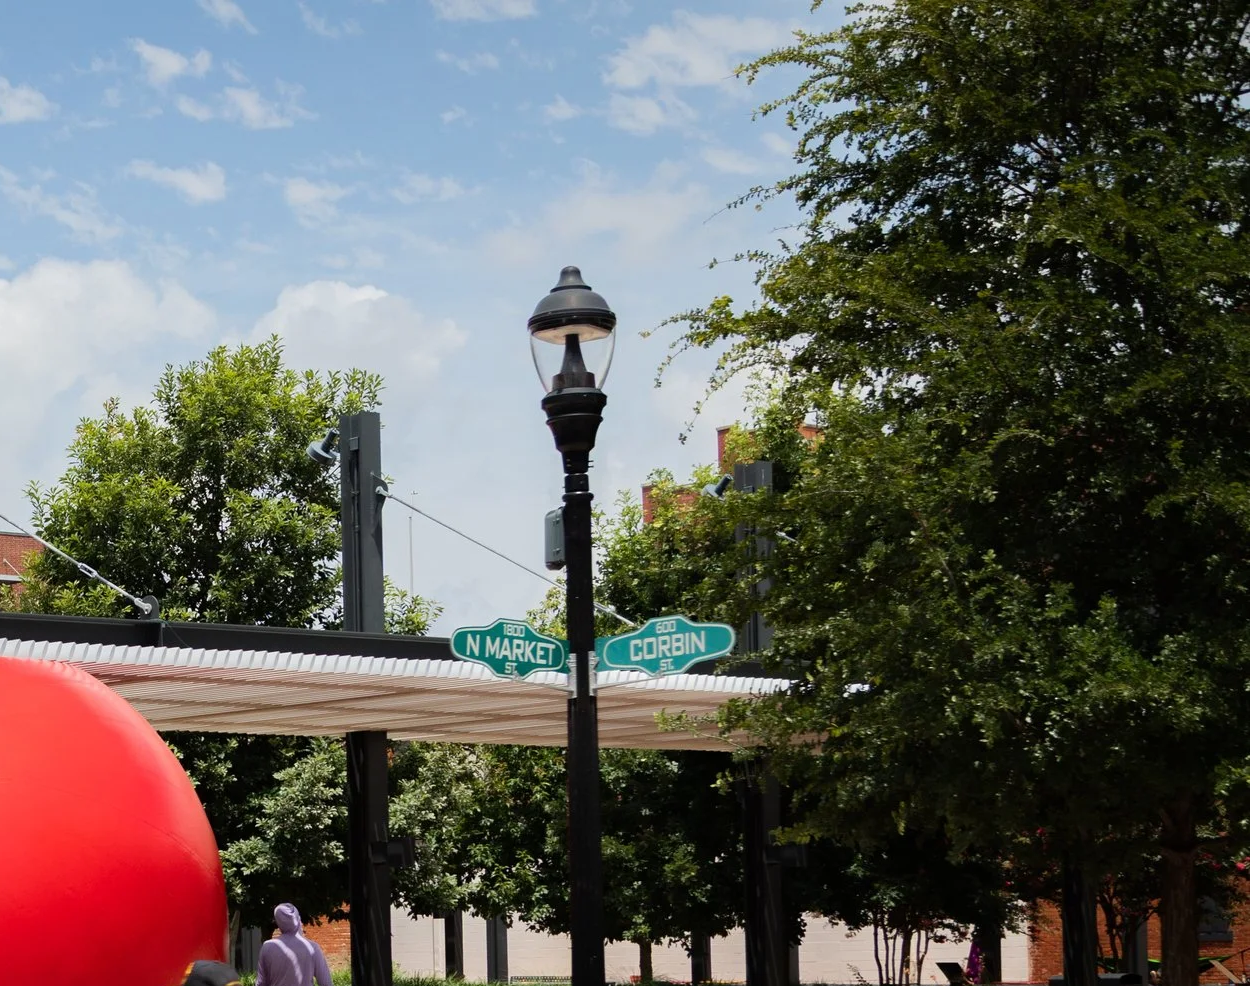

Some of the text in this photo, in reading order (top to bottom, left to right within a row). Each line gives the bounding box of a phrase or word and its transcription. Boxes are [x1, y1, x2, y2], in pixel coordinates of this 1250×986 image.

[503, 624, 525, 637] 1800
[656, 621, 676, 634] 600
[466, 633, 556, 666] N MARKET
[630, 631, 705, 661] CORBIN
